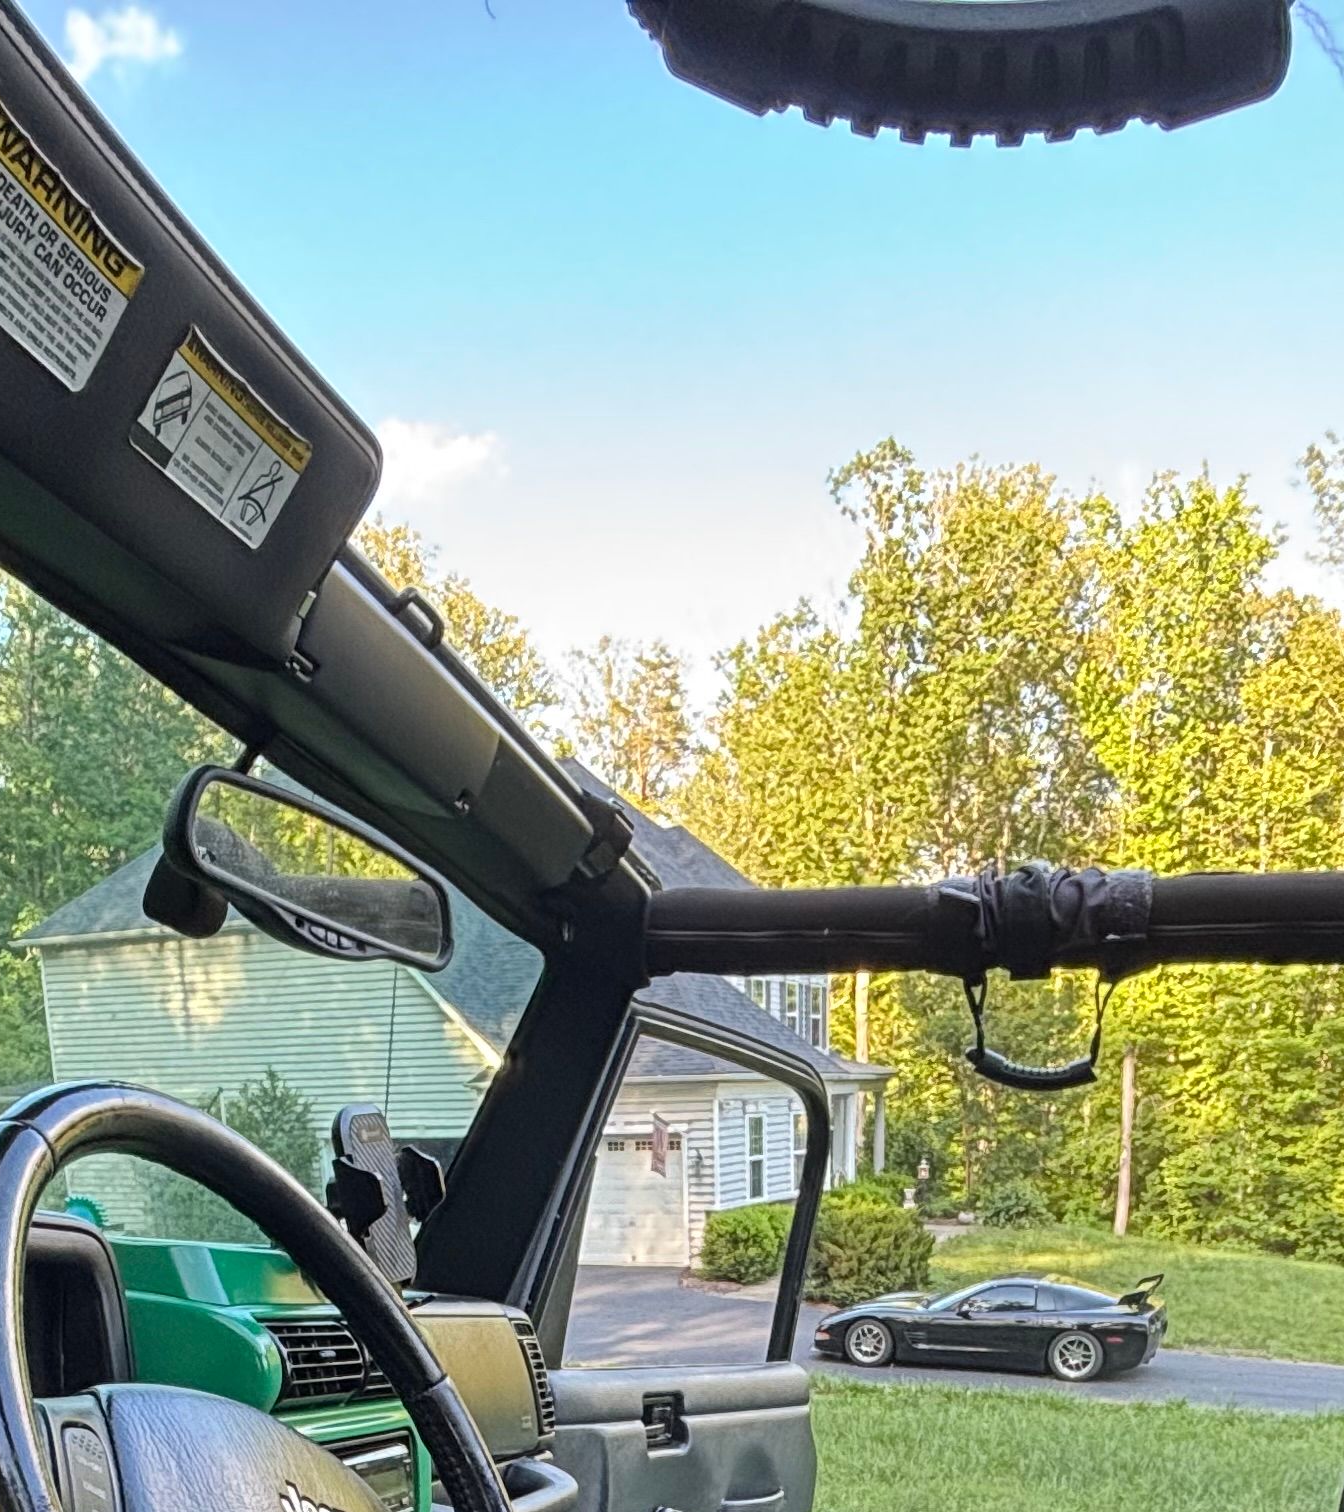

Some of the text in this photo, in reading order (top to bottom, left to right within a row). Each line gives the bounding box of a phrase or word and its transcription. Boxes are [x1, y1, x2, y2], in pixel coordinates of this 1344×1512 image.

[31, 240, 64, 278] CAN
[61, 270, 108, 323] OCCUR
[36, 219, 59, 249] OR
[56, 240, 112, 304] SERIOUS
